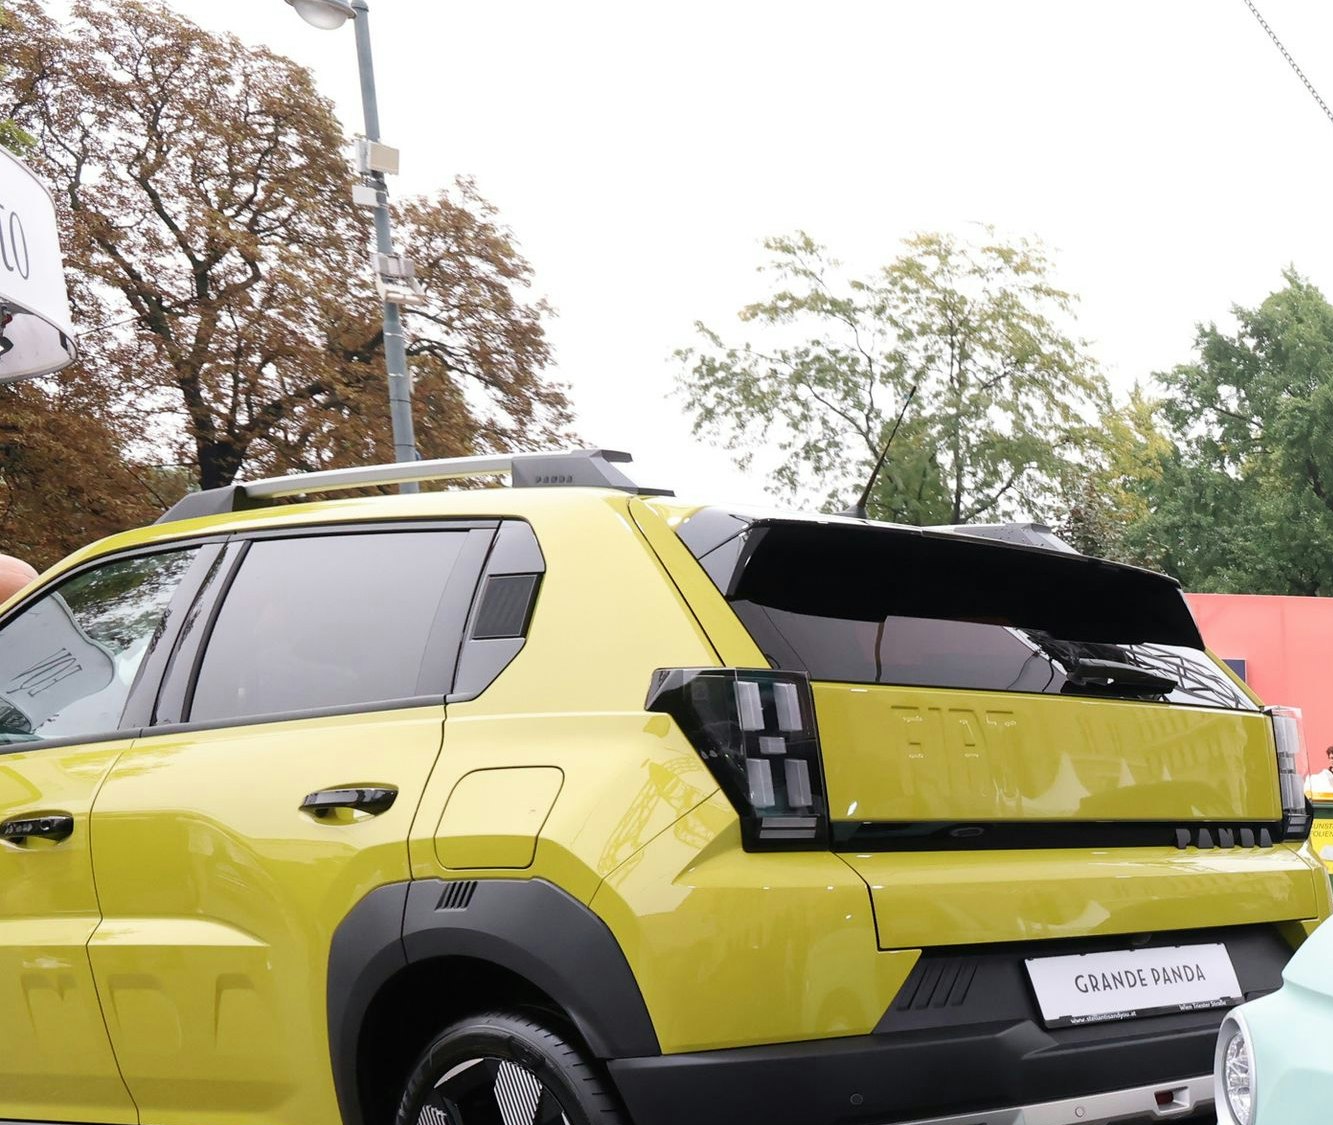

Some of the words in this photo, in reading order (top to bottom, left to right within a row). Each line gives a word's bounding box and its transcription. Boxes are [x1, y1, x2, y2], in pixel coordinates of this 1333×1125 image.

[1175, 828, 1273, 849] PANDA
[1074, 969, 1148, 993] GRANDE
[1151, 963, 1206, 986] PANDA
